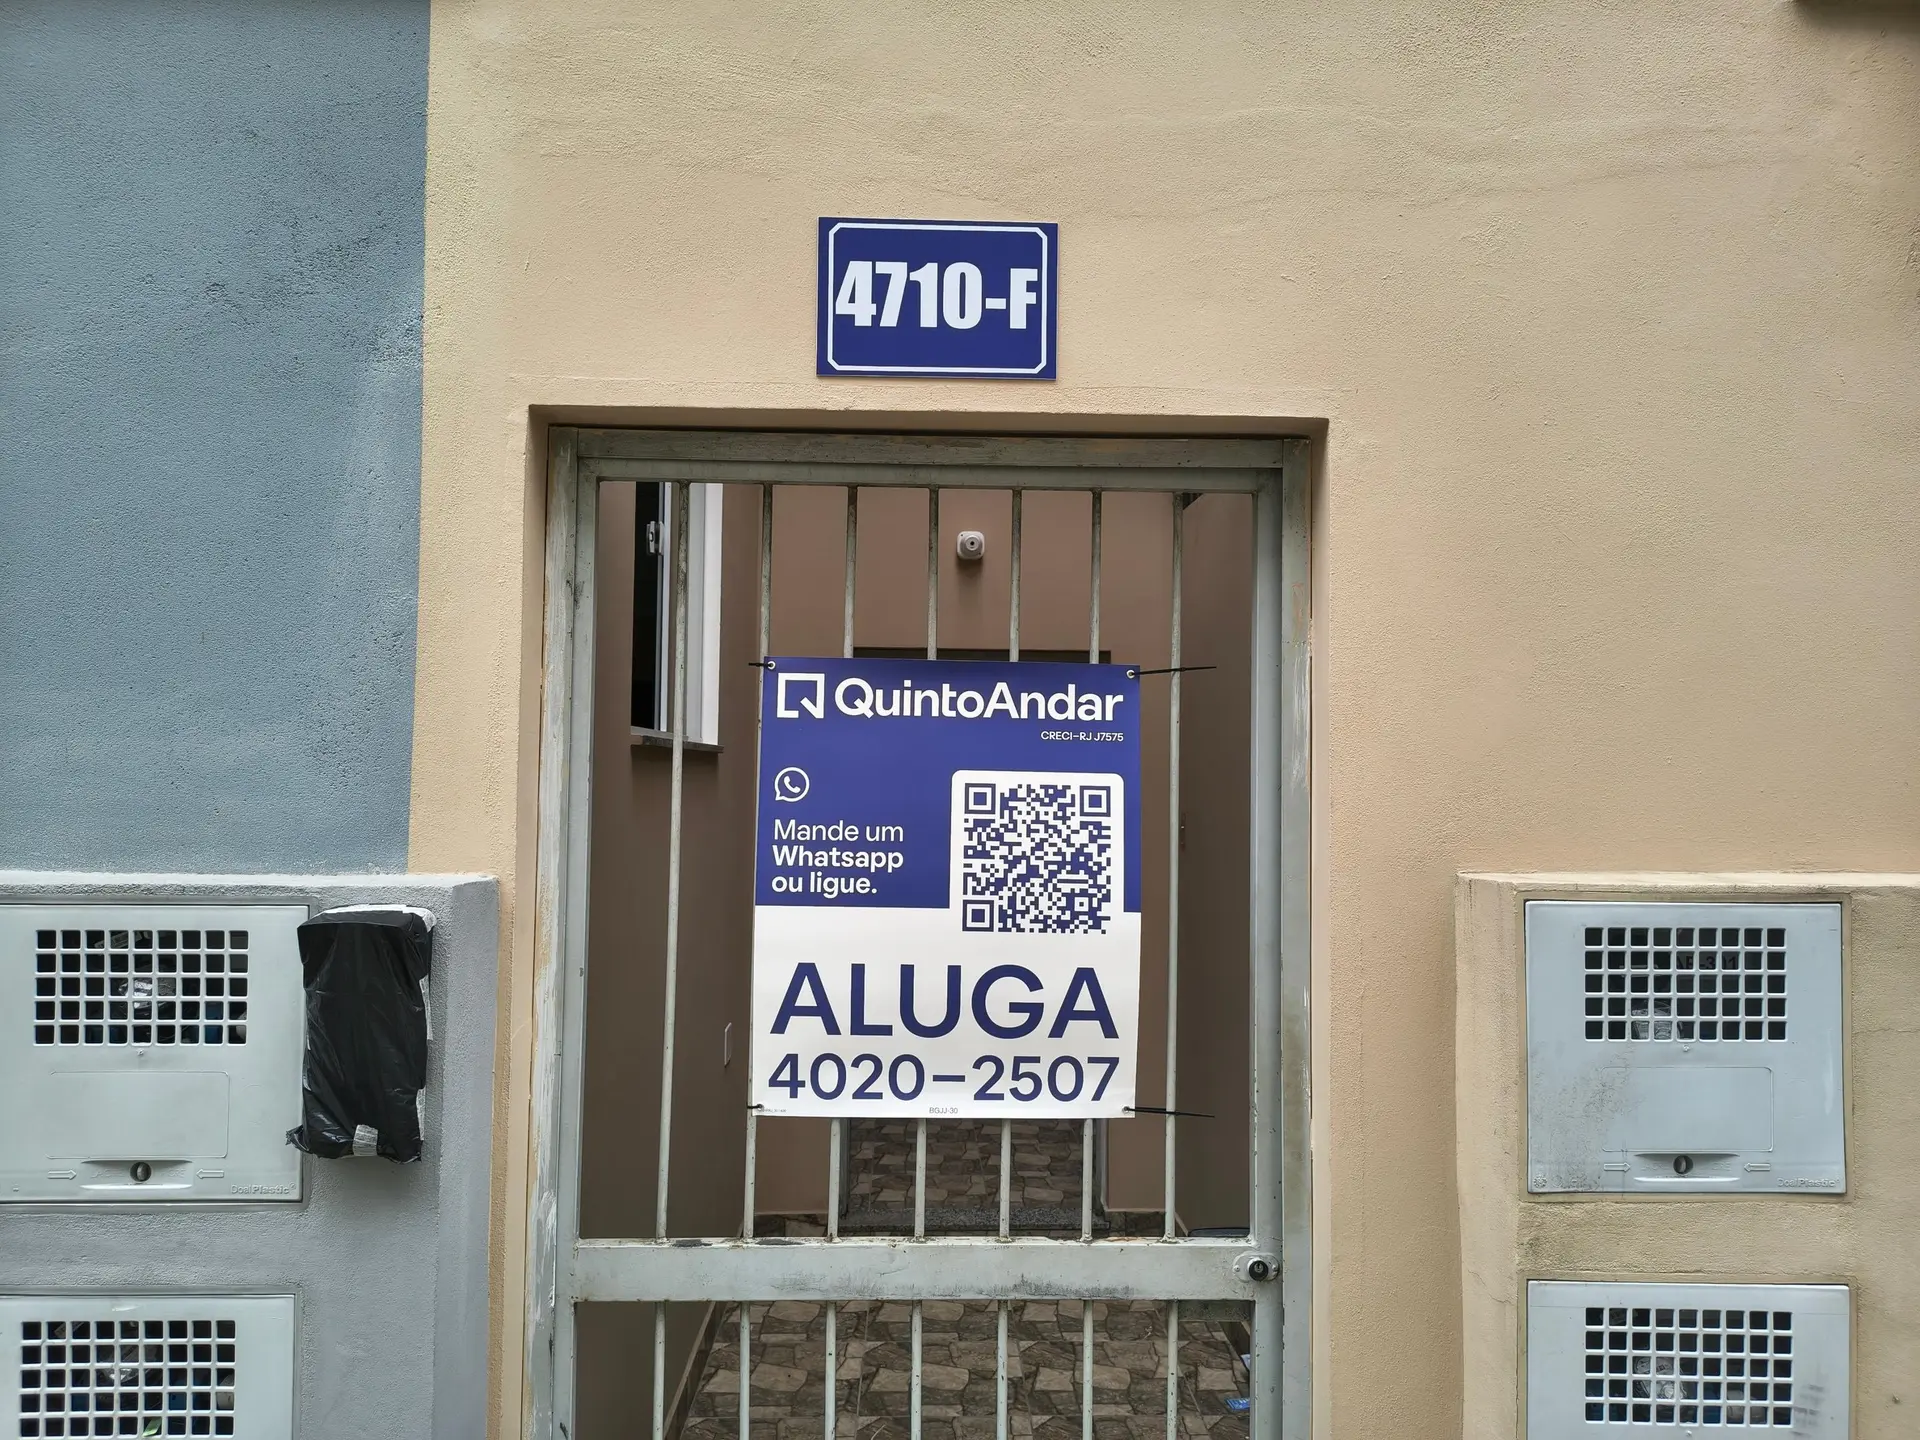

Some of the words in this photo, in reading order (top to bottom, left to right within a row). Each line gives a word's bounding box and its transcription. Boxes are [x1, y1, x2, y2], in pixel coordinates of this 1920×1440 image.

[835, 260, 1038, 330] 4710-F
[834, 677, 1124, 721] QuintoAndar
[1040, 731, 1092, 741] CRECI-RJ
[1093, 732, 1124, 742] J7575
[773, 818, 859, 842] Mande
[865, 824, 904, 842] um
[772, 845, 904, 873] Whatsapp
[771, 876, 802, 894] ou
[809, 872, 878, 899] ligue.
[769, 962, 1120, 1040] ALUGA
[768, 1052, 1120, 1102] 4020-2507
